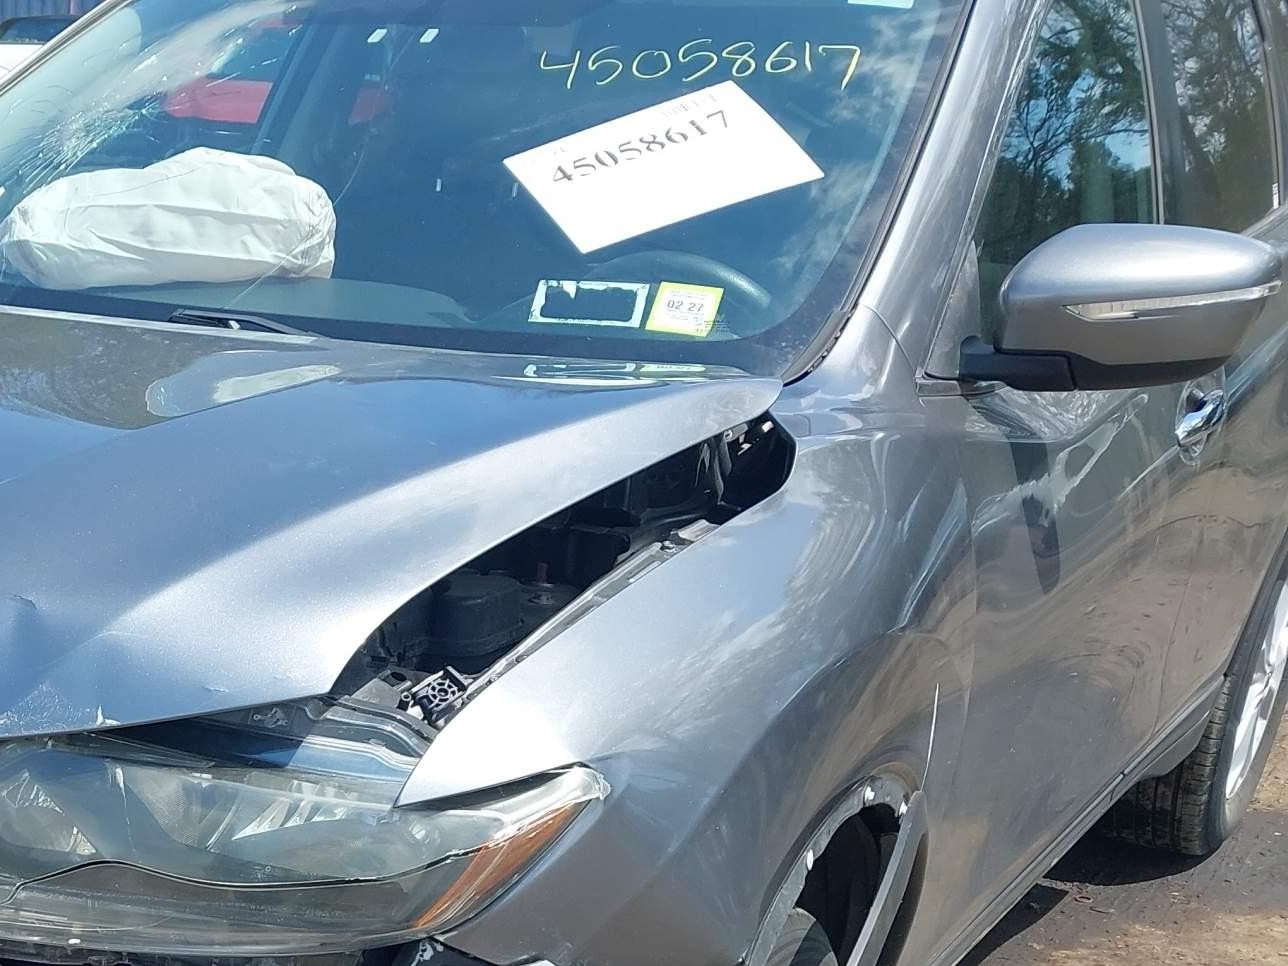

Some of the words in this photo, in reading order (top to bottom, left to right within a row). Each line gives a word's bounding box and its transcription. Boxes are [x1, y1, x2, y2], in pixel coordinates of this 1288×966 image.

[539, 38, 864, 91] 45058617
[551, 109, 731, 184] 45058617
[667, 298, 684, 311] 02
[688, 302, 705, 313] 27
